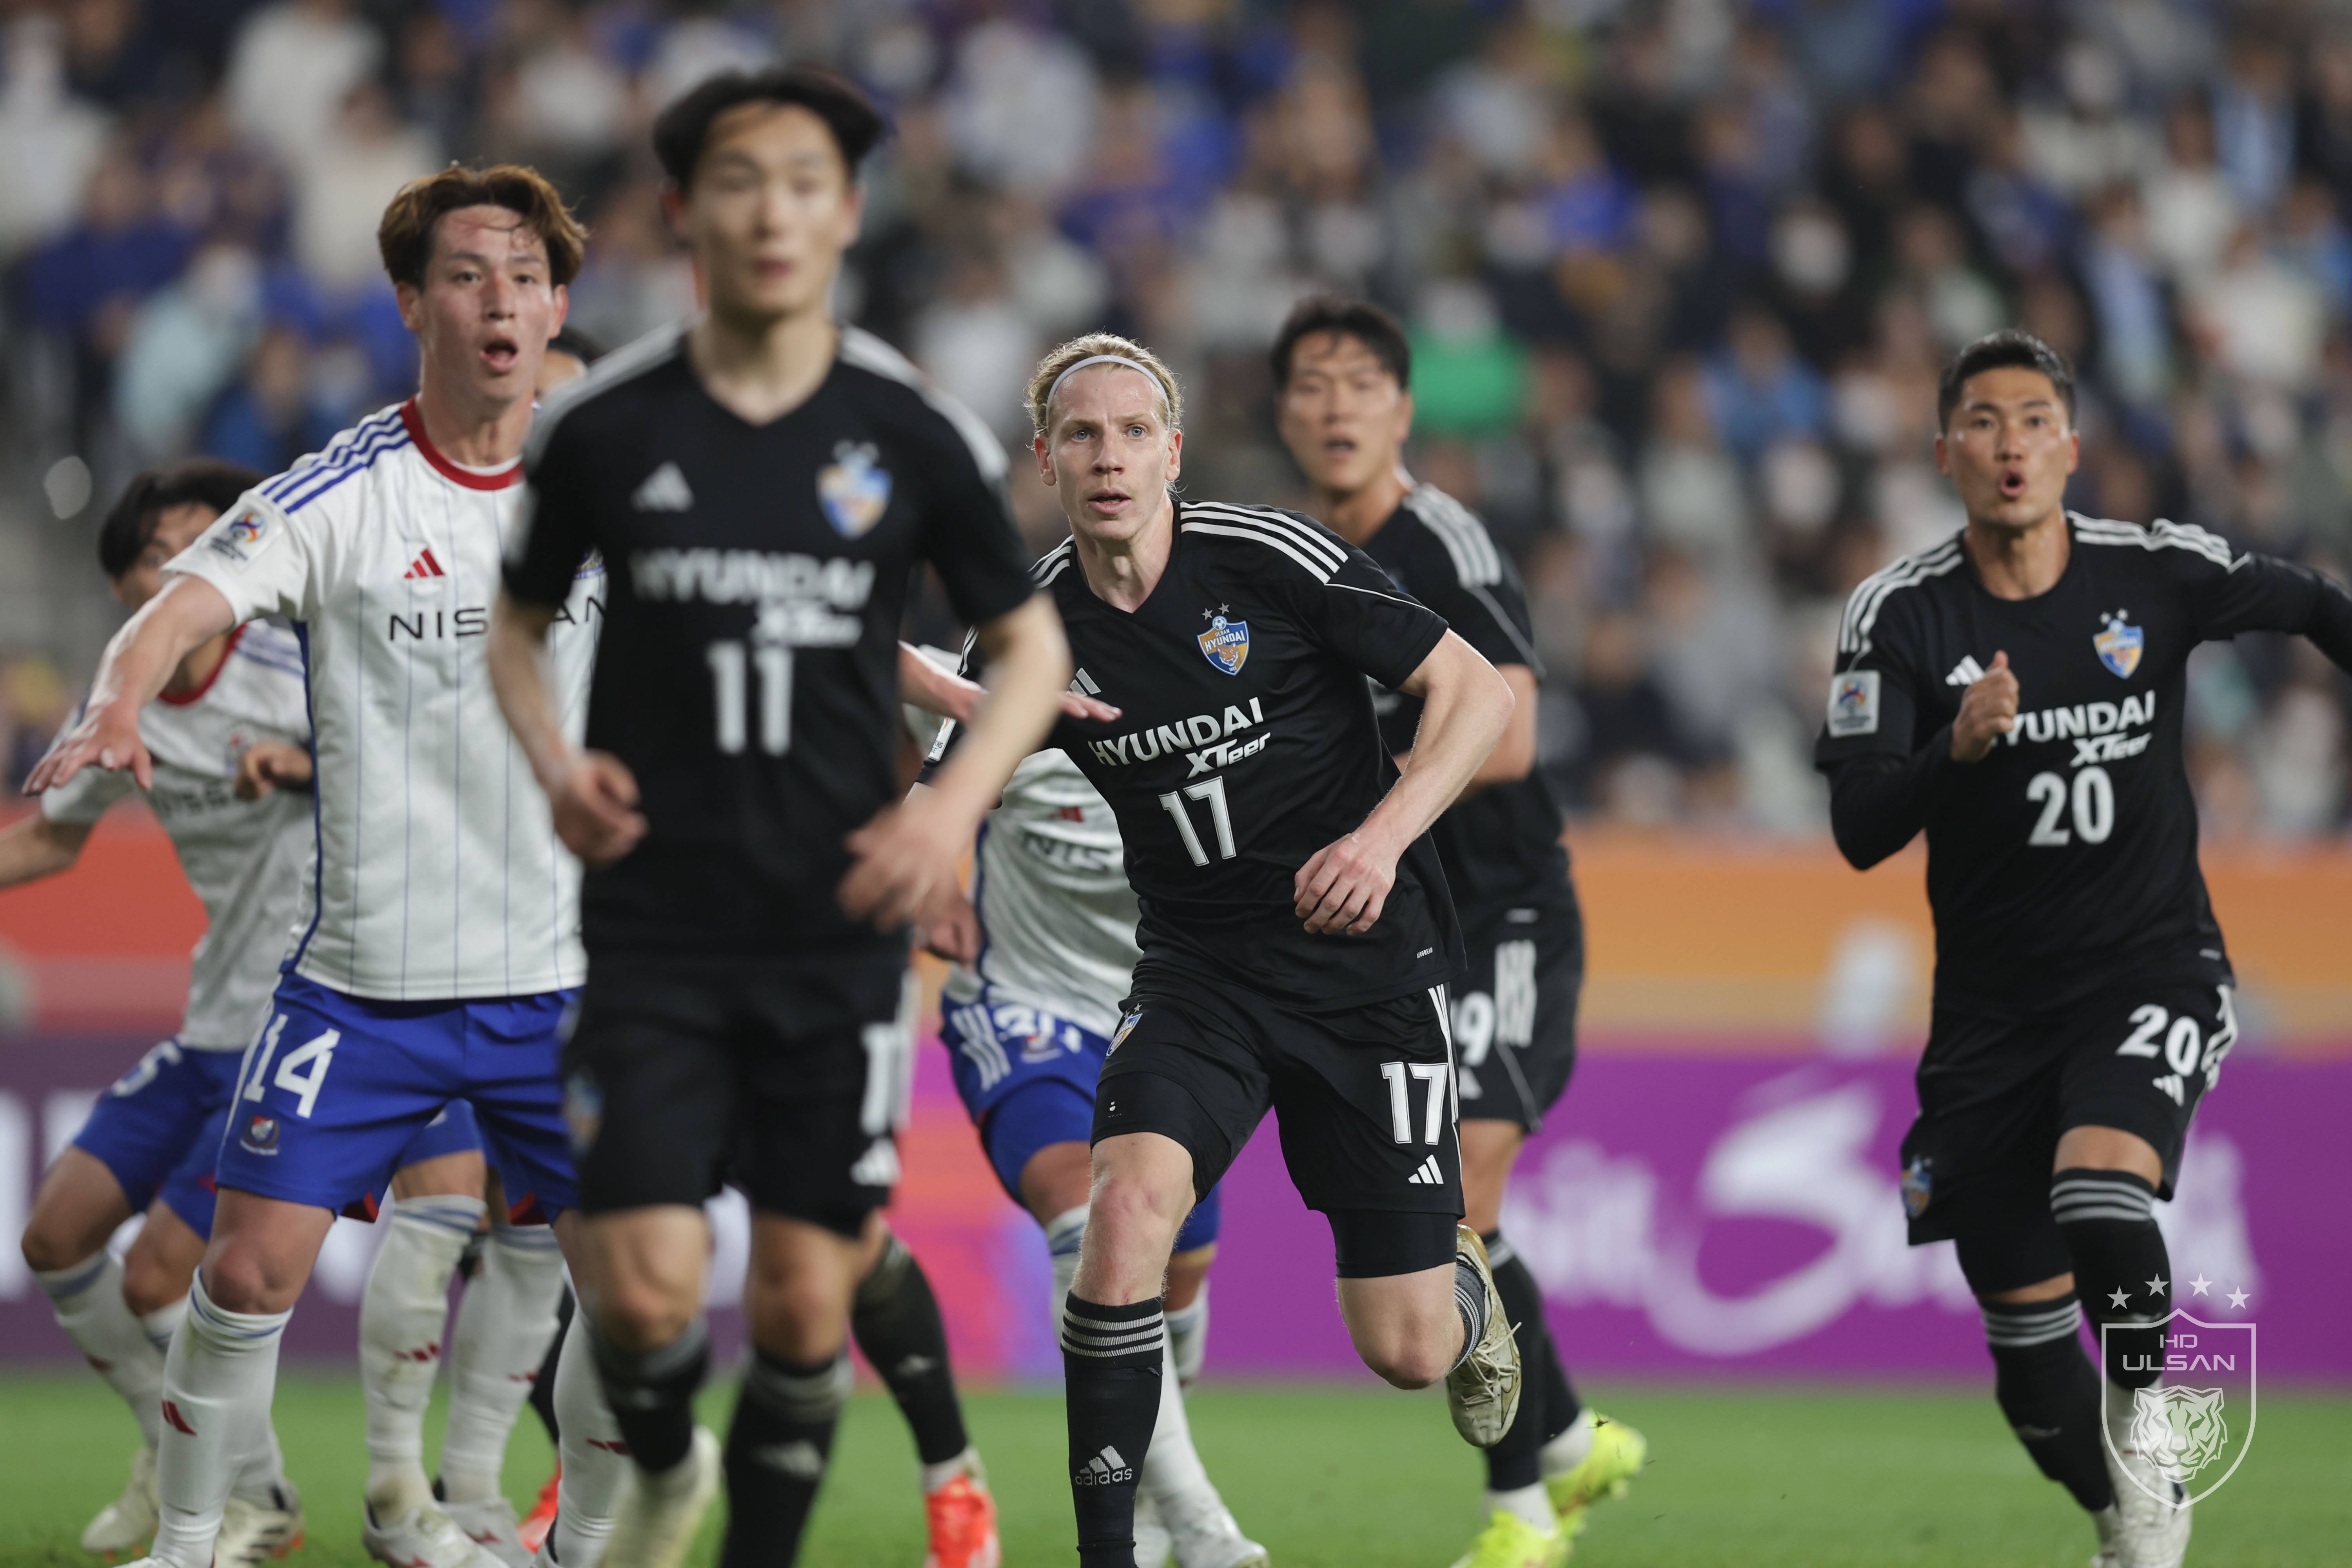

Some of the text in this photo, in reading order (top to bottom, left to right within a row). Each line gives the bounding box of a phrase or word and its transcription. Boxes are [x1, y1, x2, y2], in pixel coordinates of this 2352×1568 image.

[1204, 630, 1246, 652] HYUNDAI
[1215, 628, 1230, 637] ULSAN
[706, 639, 794, 757] 11
[1088, 696, 1264, 766] HYUNDAI
[1991, 689, 2155, 747] YUNDAI
[1158, 775, 1237, 867] 17
[2026, 765, 2116, 847] 20
[243, 1013, 341, 1119] 14
[1451, 992, 1495, 1067] 9
[2116, 1003, 2201, 1077] 20
[1380, 1061, 1448, 1145] 17
[1075, 1468, 1132, 1486] adidas
